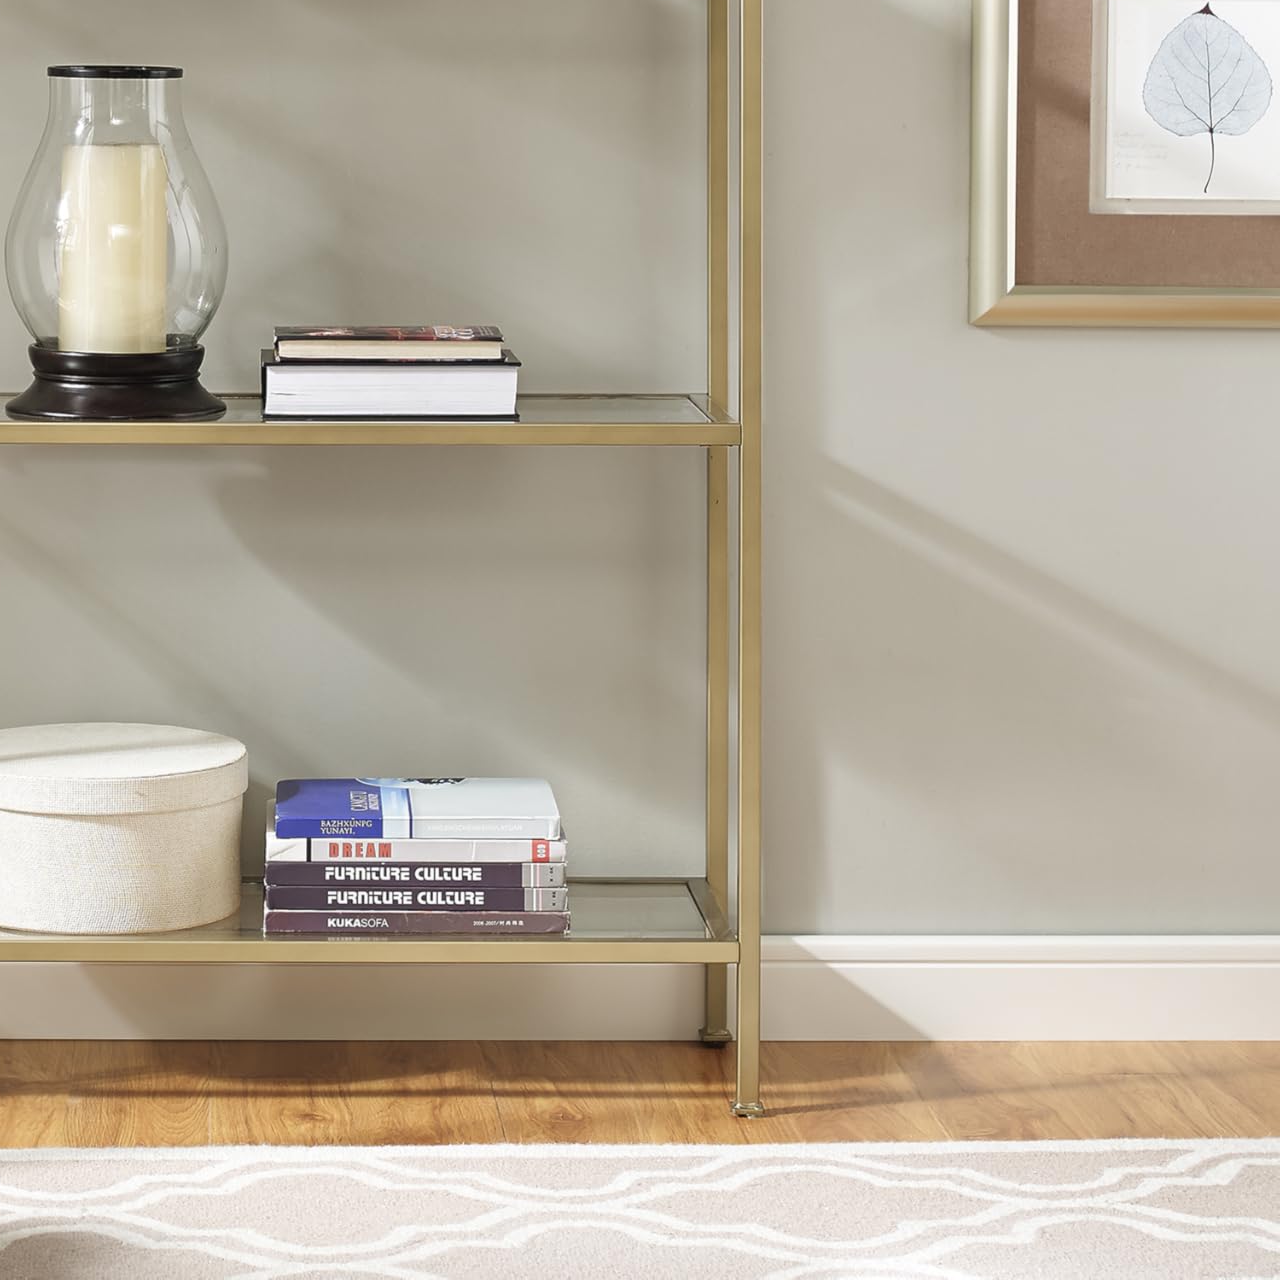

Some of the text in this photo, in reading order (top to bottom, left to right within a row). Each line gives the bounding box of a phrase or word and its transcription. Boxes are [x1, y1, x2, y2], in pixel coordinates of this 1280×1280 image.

[328, 842, 392, 858] DREAM
[414, 866, 482, 881] CULTURE
[416, 890, 485, 905] CULTURE
